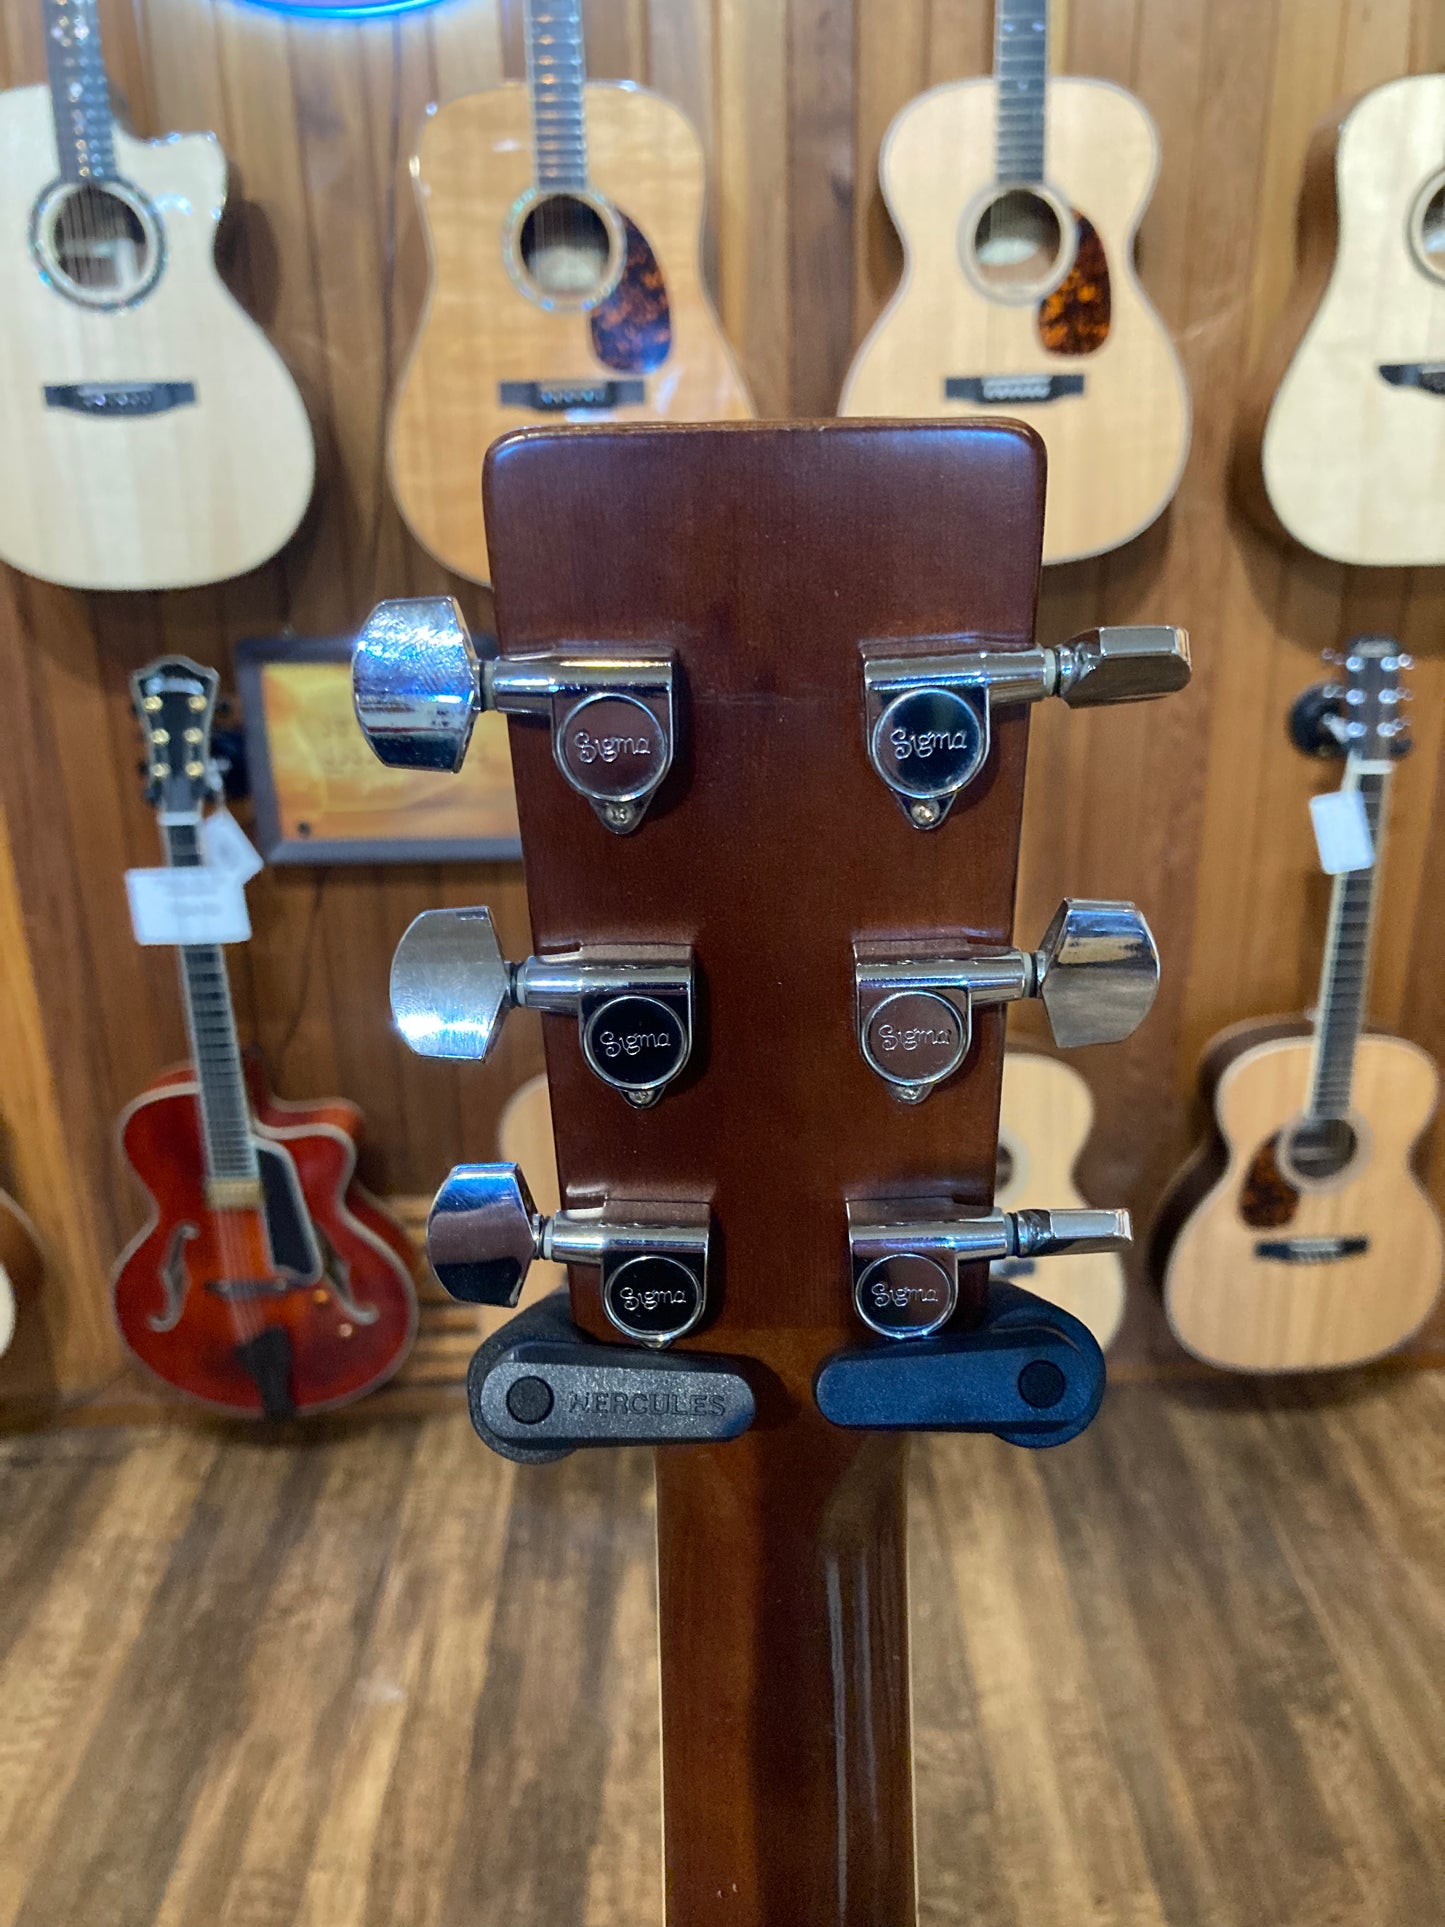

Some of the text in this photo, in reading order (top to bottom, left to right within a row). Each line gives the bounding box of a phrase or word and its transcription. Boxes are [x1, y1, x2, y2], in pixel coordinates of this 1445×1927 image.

[574, 731, 651, 763] Sigma
[890, 727, 968, 760] Sigma
[600, 1031, 671, 1057] Sigma
[879, 1024, 951, 1051] Sigma
[620, 1286, 687, 1311] Sigma
[871, 1283, 938, 1307] Sigma
[568, 1391, 726, 1416] HERCULES
